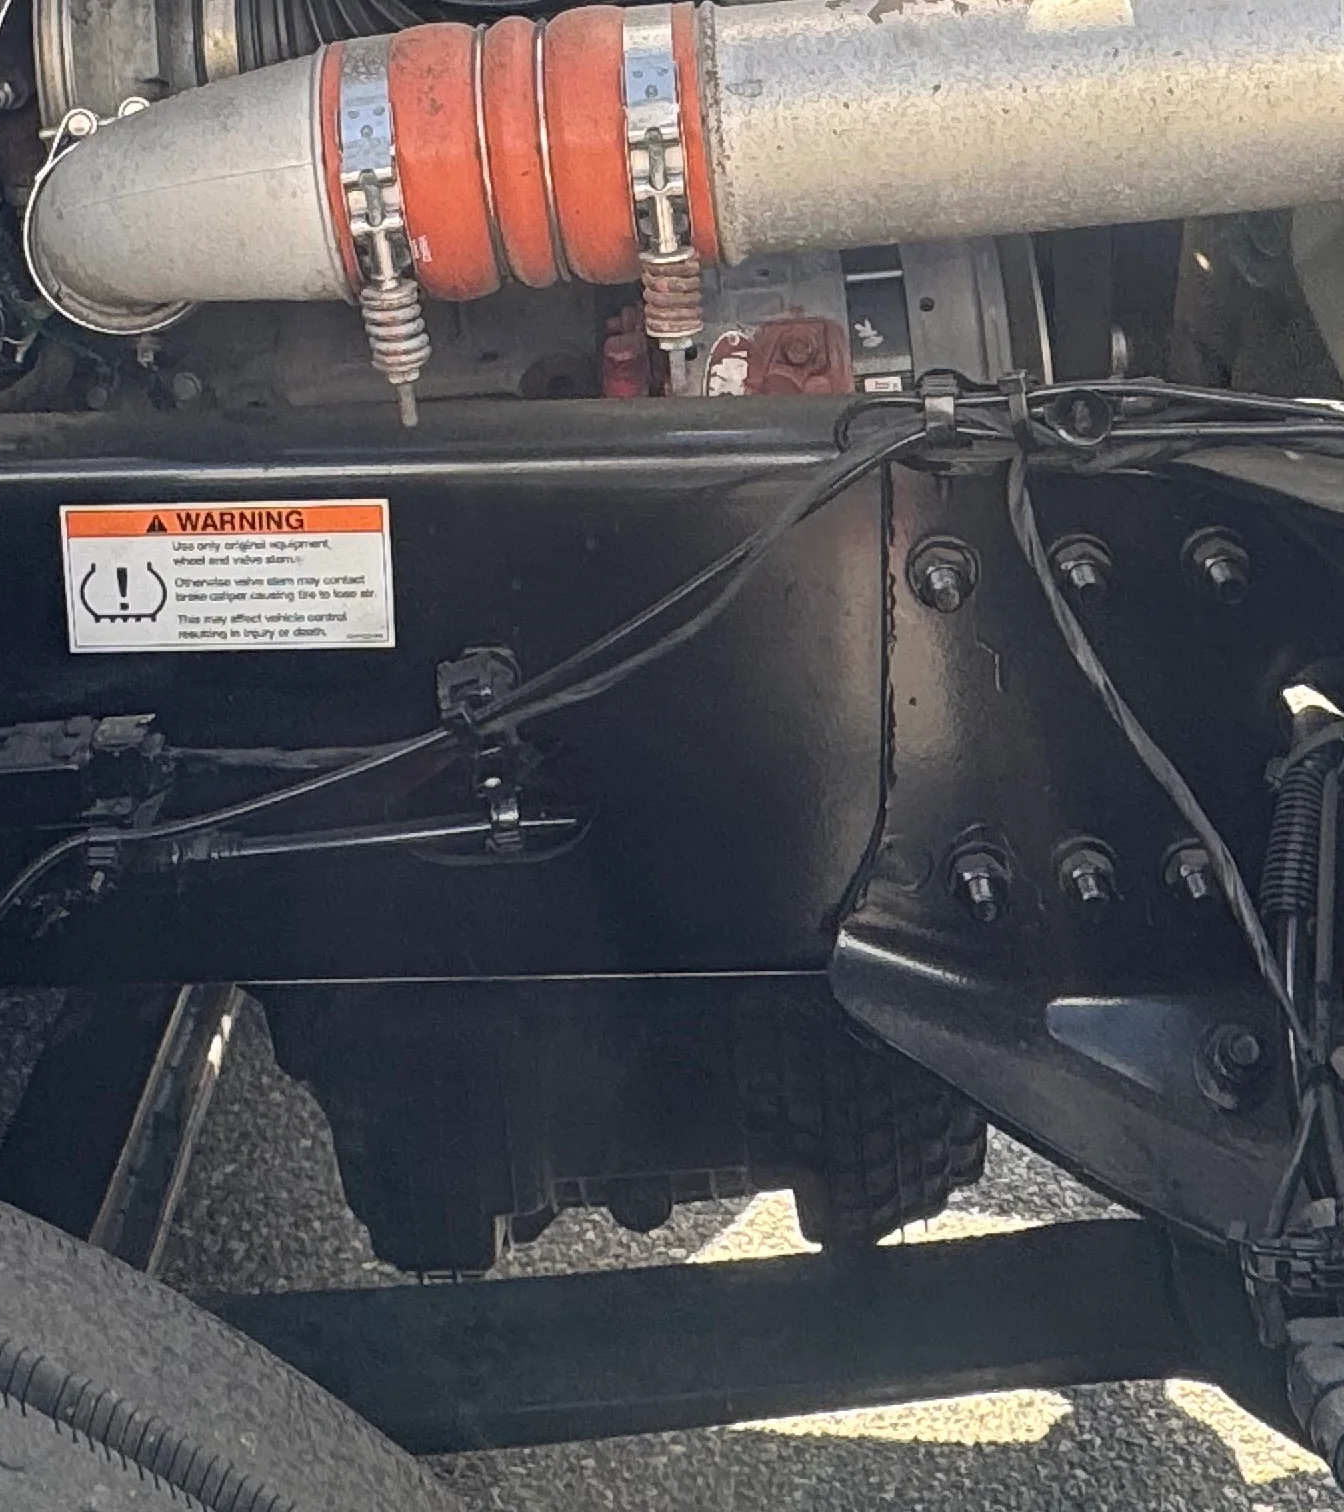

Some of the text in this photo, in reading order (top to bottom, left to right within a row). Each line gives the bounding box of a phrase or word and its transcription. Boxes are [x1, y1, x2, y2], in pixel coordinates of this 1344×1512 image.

[176, 510, 304, 532] WARNING
[209, 555, 230, 566] and
[297, 577, 320, 588] may
[323, 575, 366, 586] contact
[318, 589, 331, 600] to
[278, 628, 290, 638] or
